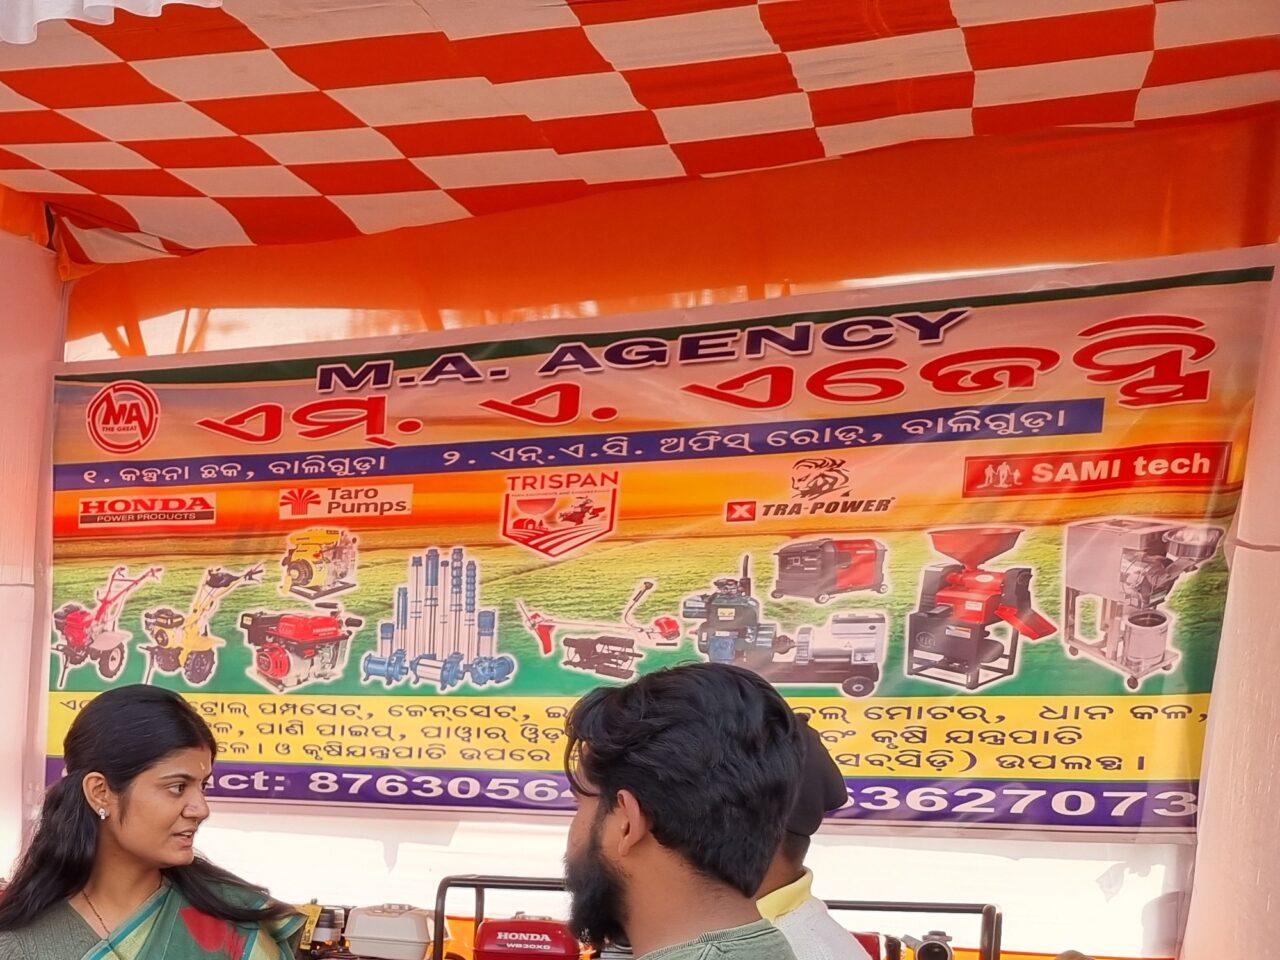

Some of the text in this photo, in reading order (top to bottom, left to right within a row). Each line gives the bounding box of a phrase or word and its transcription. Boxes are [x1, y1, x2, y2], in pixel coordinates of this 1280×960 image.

[318, 308, 972, 391] M.A. AGENCY
[479, 382, 619, 424] ଏ.
[1031, 452, 1211, 484] SAMI tech
[507, 471, 618, 491] TRISPAN
[328, 487, 378, 500] Taro
[79, 496, 215, 514] HONDA
[96, 512, 196, 523] POWER PRODUCTS
[308, 772, 575, 801] 8763056
[844, 786, 1198, 817] 3627073
[496, 931, 552, 942] HONDA
